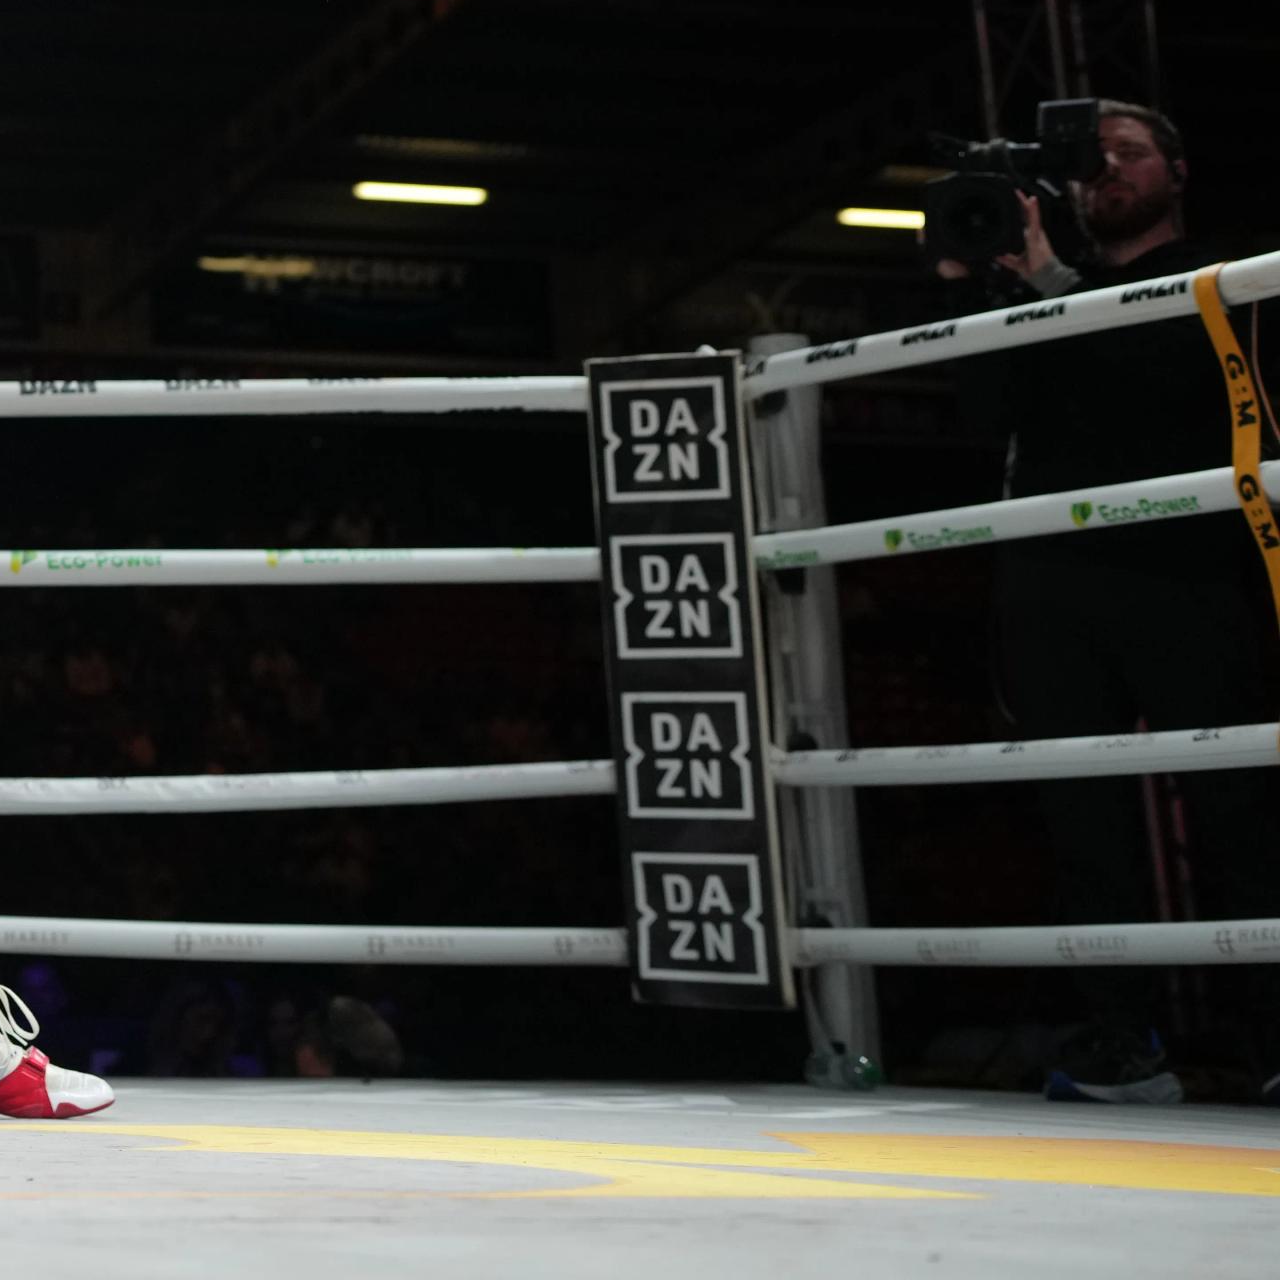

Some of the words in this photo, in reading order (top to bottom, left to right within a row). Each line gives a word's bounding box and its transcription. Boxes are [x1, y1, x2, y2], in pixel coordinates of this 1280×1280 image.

[629, 397, 700, 438] DA
[632, 441, 701, 483] ZN
[639, 553, 711, 594] DA
[643, 597, 712, 639] ZN
[650, 711, 723, 753] DA
[653, 757, 724, 800] ZN
[661, 873, 735, 916] DA
[2, 930, 71, 946] HARLEY
[667, 919, 737, 963] ZN
